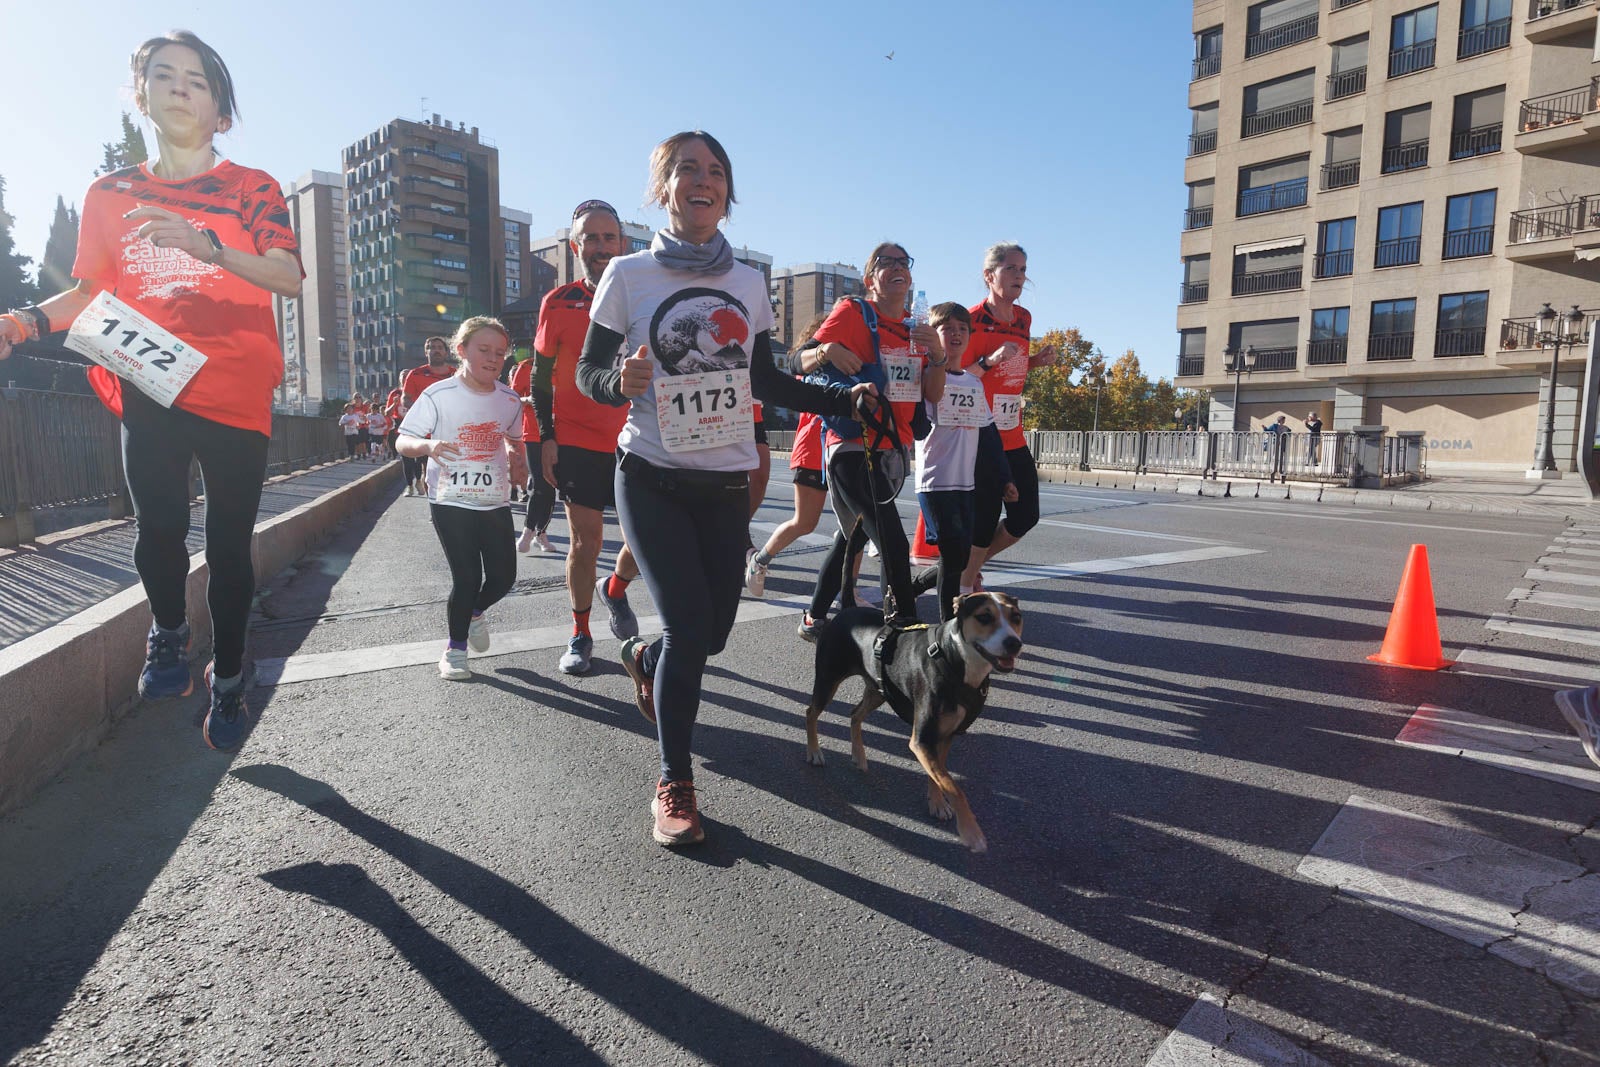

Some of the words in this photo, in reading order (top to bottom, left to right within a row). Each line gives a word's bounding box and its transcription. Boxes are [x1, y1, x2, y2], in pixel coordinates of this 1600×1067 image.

[124, 243, 190, 260] carre
[101, 318, 177, 372] 1172
[112, 349, 145, 371] PONTOS
[890, 366, 910, 381] 722
[672, 387, 737, 415] 1173
[949, 393, 975, 408] 723
[698, 415, 724, 425] ARAMIS
[450, 471, 492, 486] 1170
